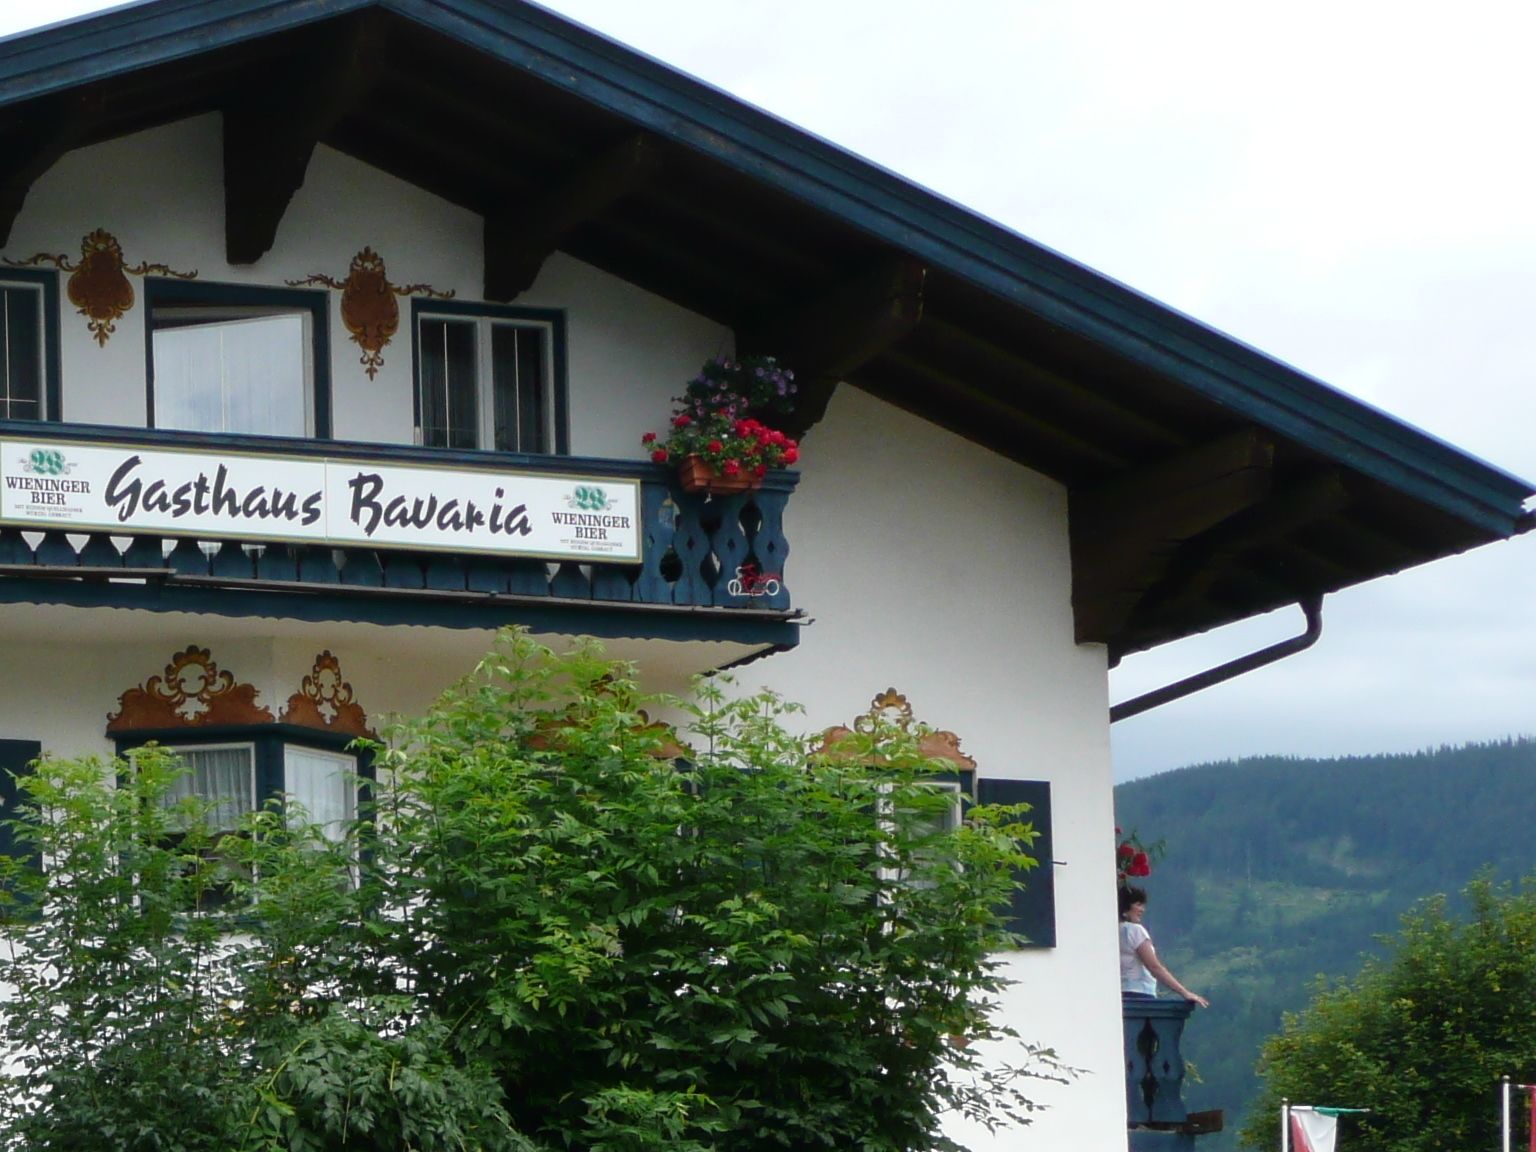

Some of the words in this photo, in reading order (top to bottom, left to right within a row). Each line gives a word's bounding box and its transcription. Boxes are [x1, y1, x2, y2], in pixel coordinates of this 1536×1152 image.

[5, 476, 91, 494] WIENINGER
[31, 491, 67, 506] BIER
[105, 455, 323, 526] Gasthaus
[348, 472, 533, 537] Bavaria
[551, 512, 630, 529] WIENINGER
[575, 526, 608, 540] BIER
